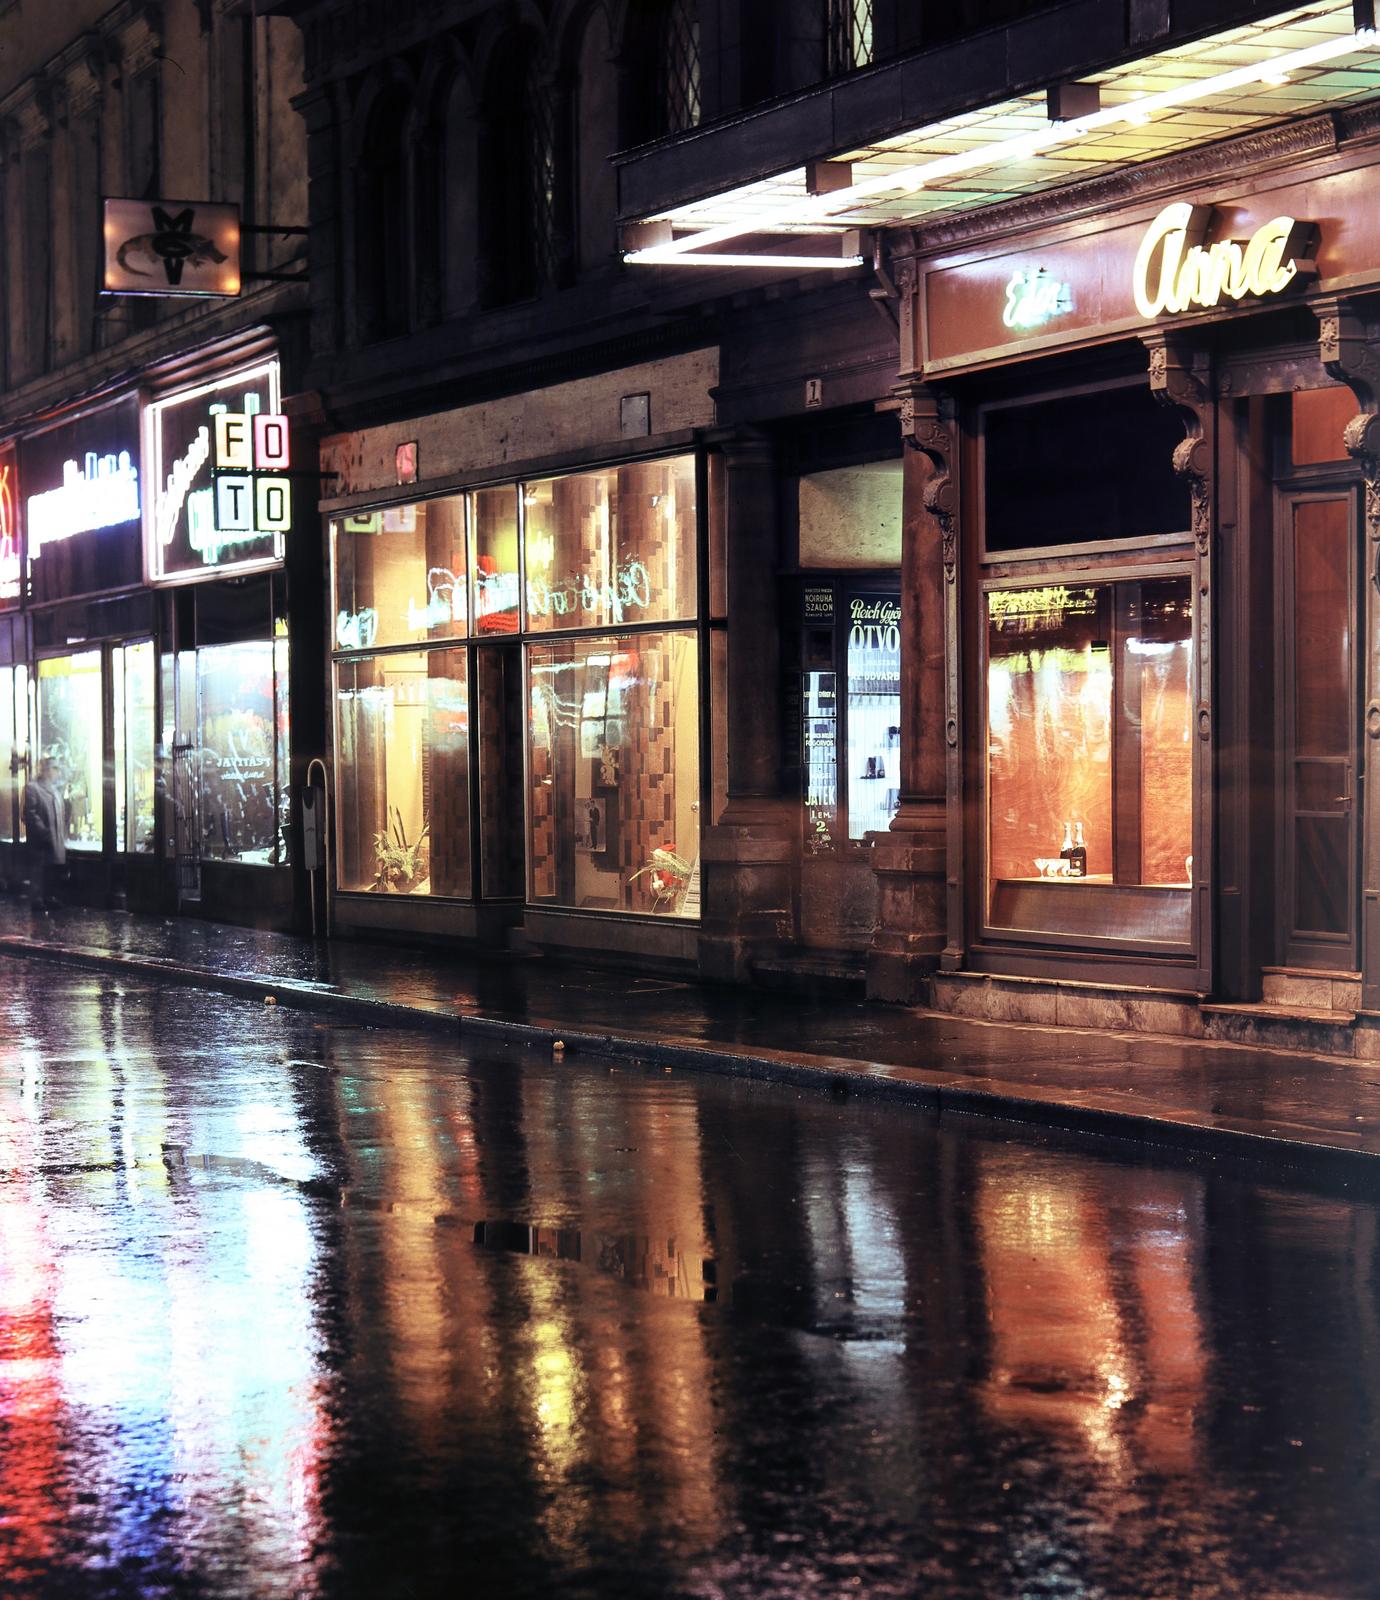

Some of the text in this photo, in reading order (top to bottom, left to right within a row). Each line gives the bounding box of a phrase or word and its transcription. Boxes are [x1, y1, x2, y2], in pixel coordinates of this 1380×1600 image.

[1132, 201, 1297, 319] Anna
[805, 603, 833, 612] SZALON
[850, 599, 880, 619] Reich
